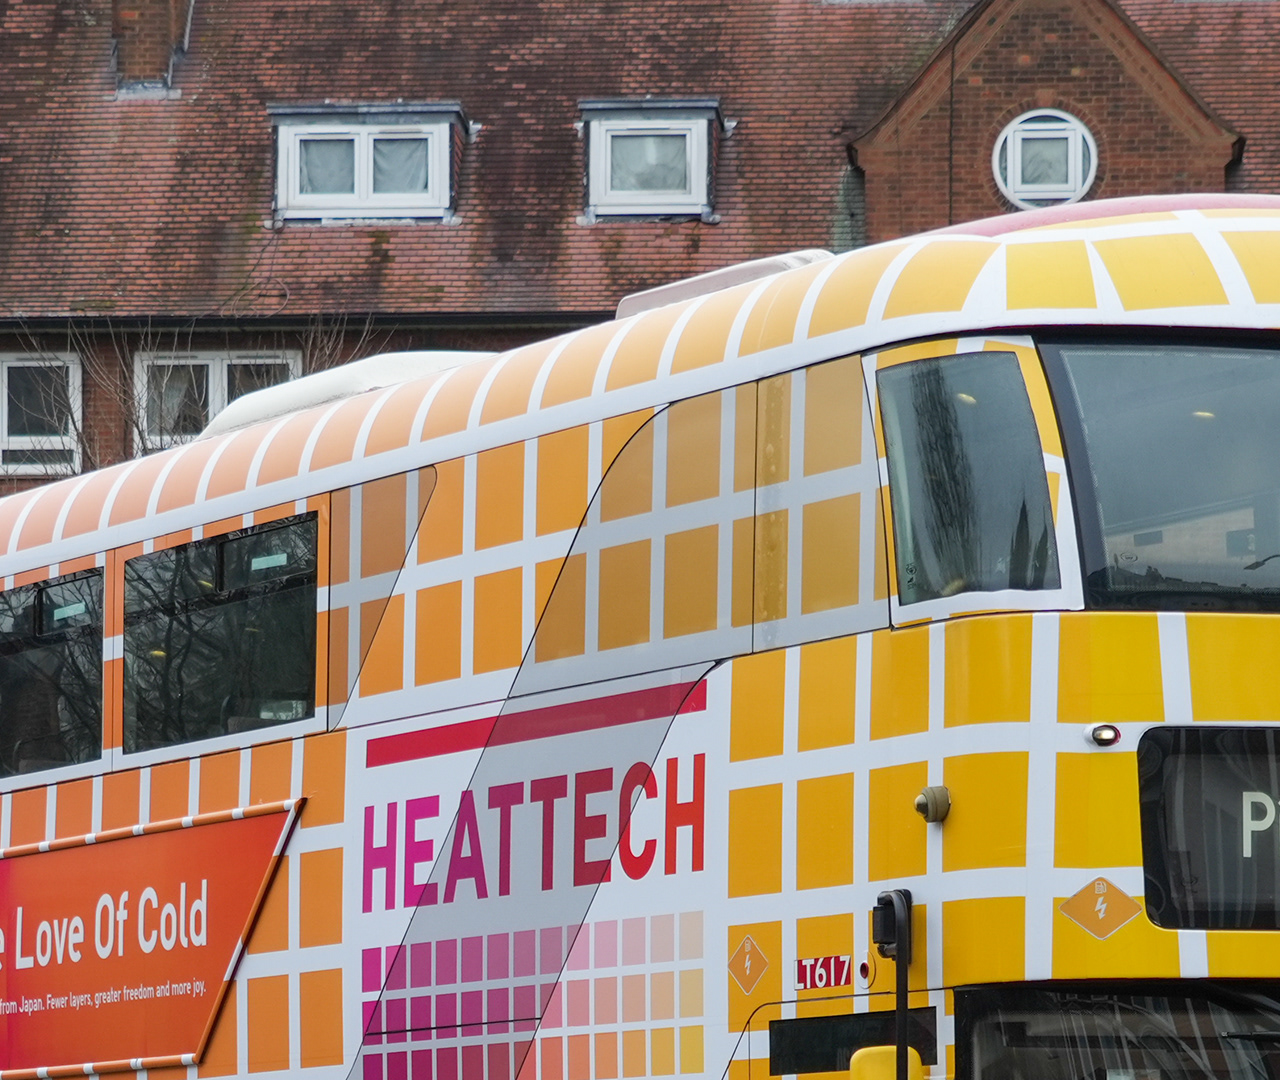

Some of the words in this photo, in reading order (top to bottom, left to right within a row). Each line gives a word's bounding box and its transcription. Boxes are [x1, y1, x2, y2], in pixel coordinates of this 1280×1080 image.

[362, 753, 706, 913] HEATTECH
[15, 906, 84, 970] Love
[94, 890, 129, 959] Of
[137, 879, 207, 954] Cold
[0, 998, 18, 1015] from
[19, 995, 45, 1016] Japan.
[46, 993, 68, 1010] Fewer
[69, 992, 93, 1011] layers,
[94, 987, 122, 1008] greater
[123, 983, 155, 1002] freedom
[156, 980, 170, 997] and
[171, 982, 192, 996] more
[192, 977, 207, 998] joy.
[794, 955, 851, 991] LT617
